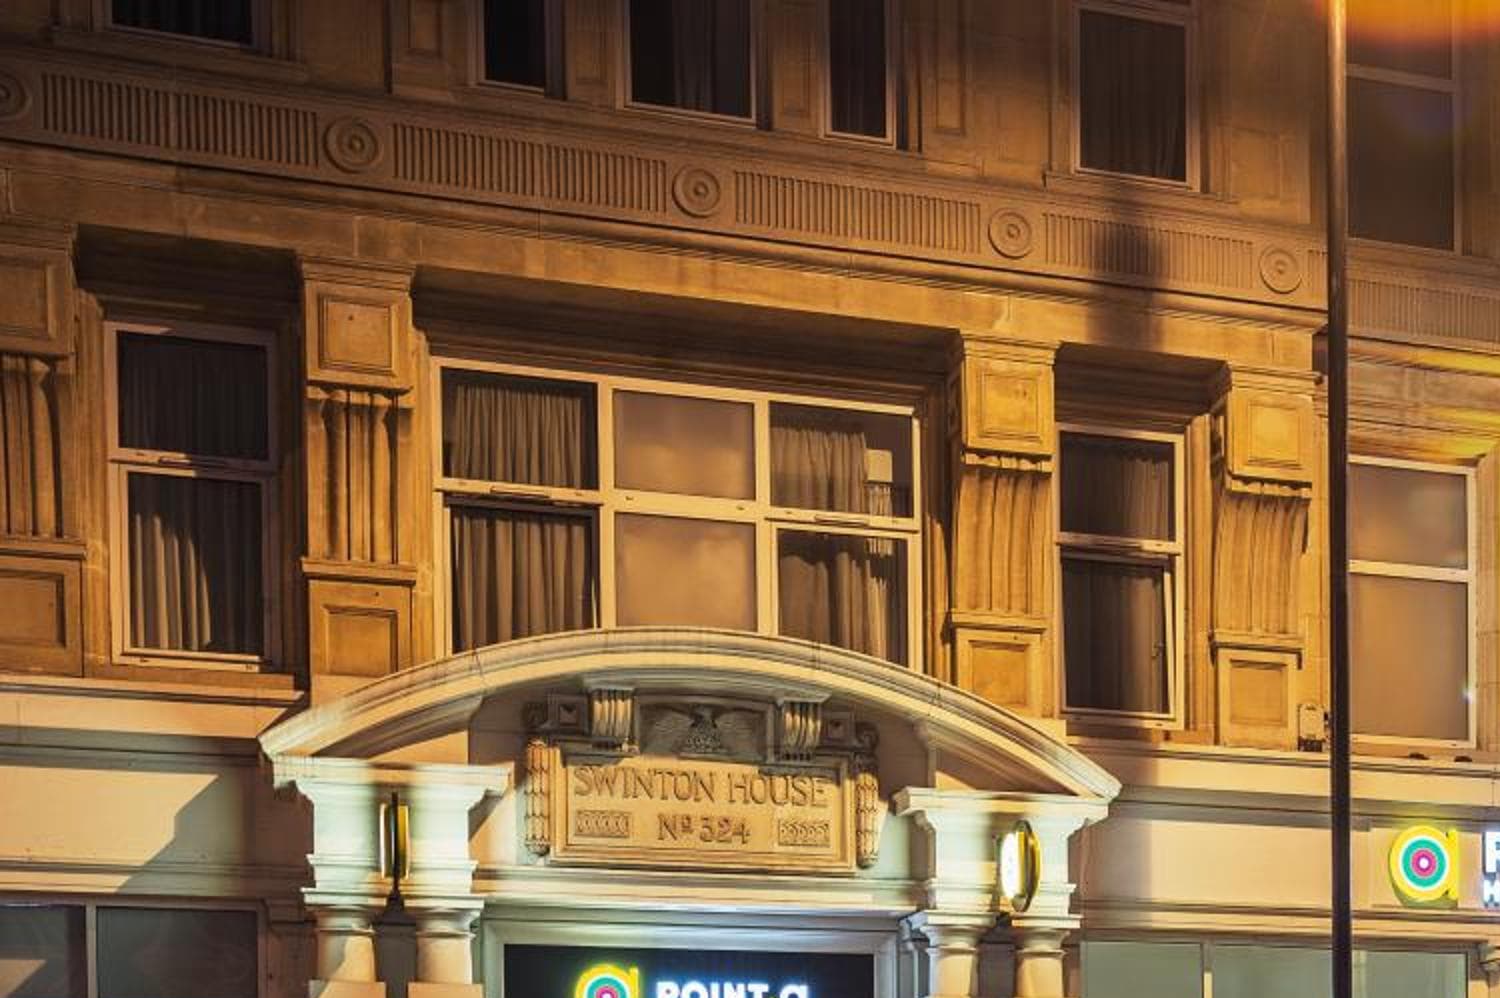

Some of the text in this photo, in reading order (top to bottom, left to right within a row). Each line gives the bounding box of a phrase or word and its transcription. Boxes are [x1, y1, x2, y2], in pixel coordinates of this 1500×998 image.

[573, 766, 828, 808] SWINTON HOUSE
[700, 816, 750, 844] 324
